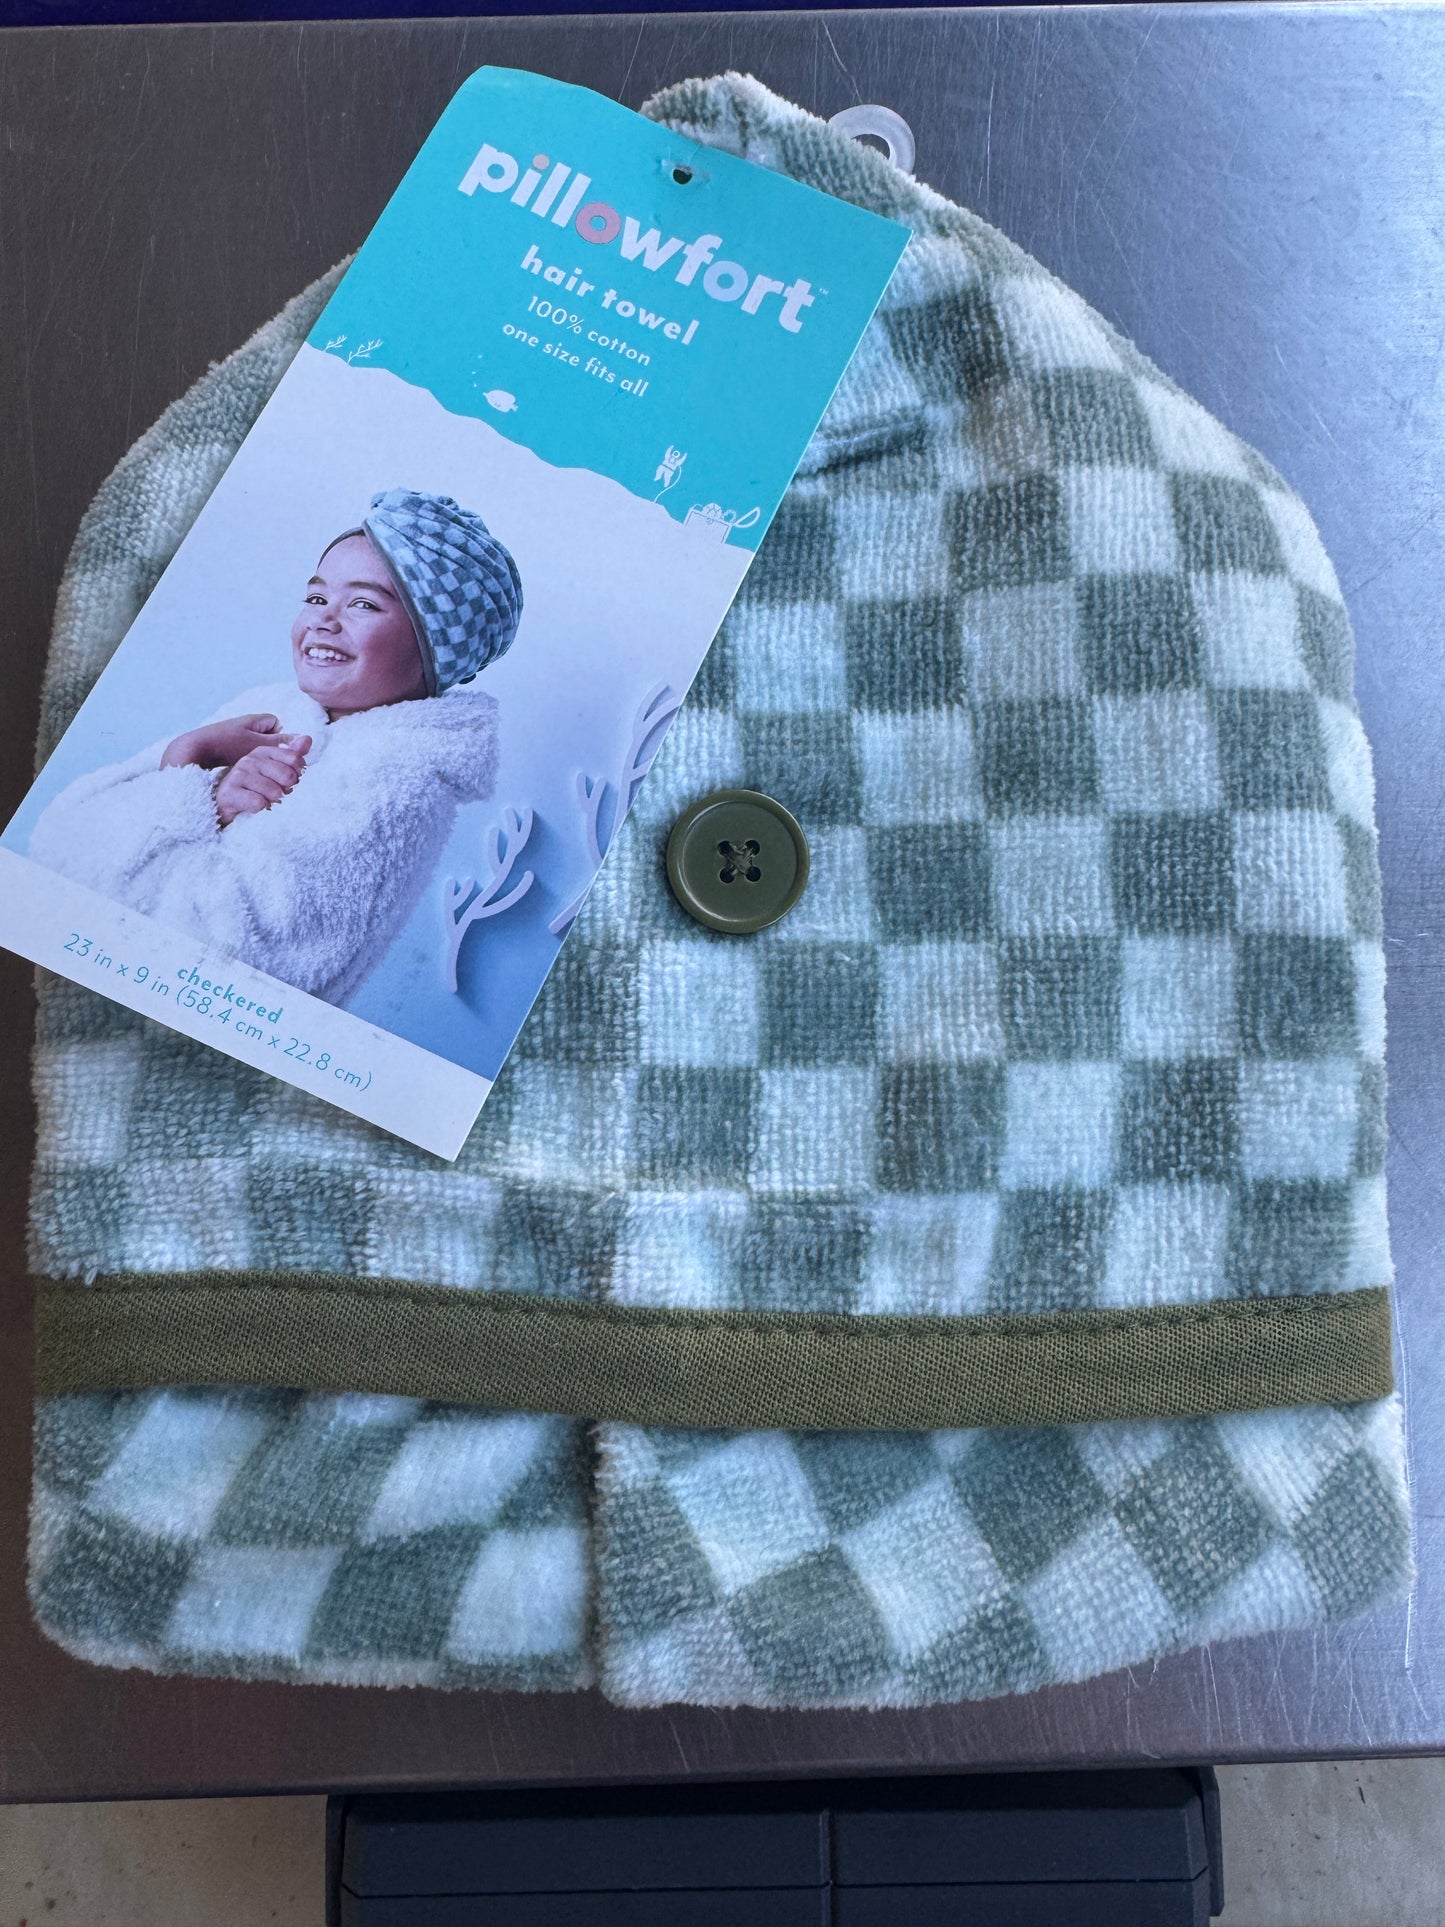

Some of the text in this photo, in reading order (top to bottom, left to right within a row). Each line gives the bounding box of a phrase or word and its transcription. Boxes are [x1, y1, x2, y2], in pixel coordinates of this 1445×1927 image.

[458, 143, 815, 333] pillowfort
[520, 245, 699, 345] hair towel
[527, 297, 650, 366] 100% cotton
[503, 322, 649, 397] one size fits all
[63, 933, 373, 1091] 23 in x 9 in (58.4 cm x 22.8 cm)
[177, 964, 283, 1023] checkered
